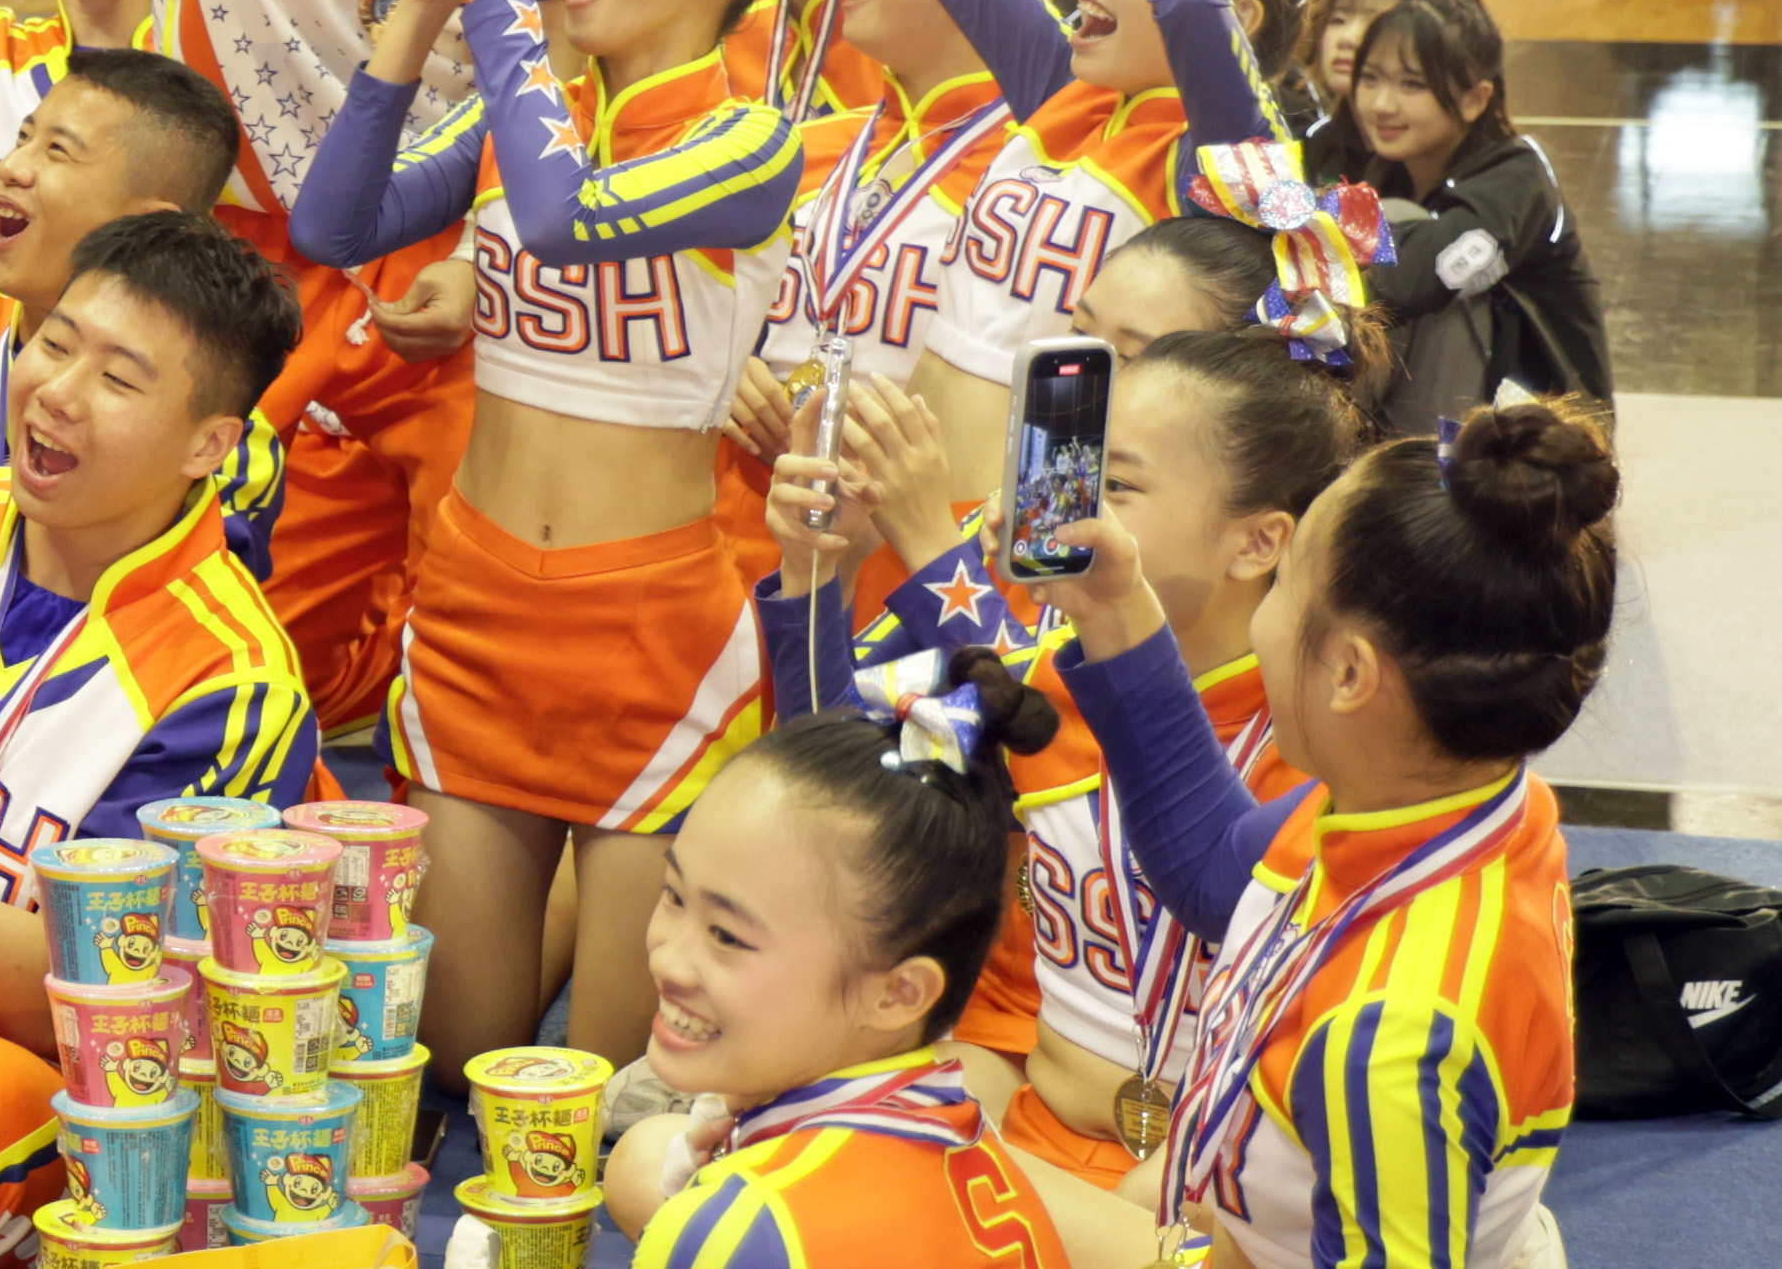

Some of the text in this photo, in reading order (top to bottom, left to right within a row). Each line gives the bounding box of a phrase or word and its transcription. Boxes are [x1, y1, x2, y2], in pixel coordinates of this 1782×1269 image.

[939, 178, 1116, 315] SH
[1679, 980, 1743, 1010] NIKE
[532, 1133, 570, 1156] Prince
